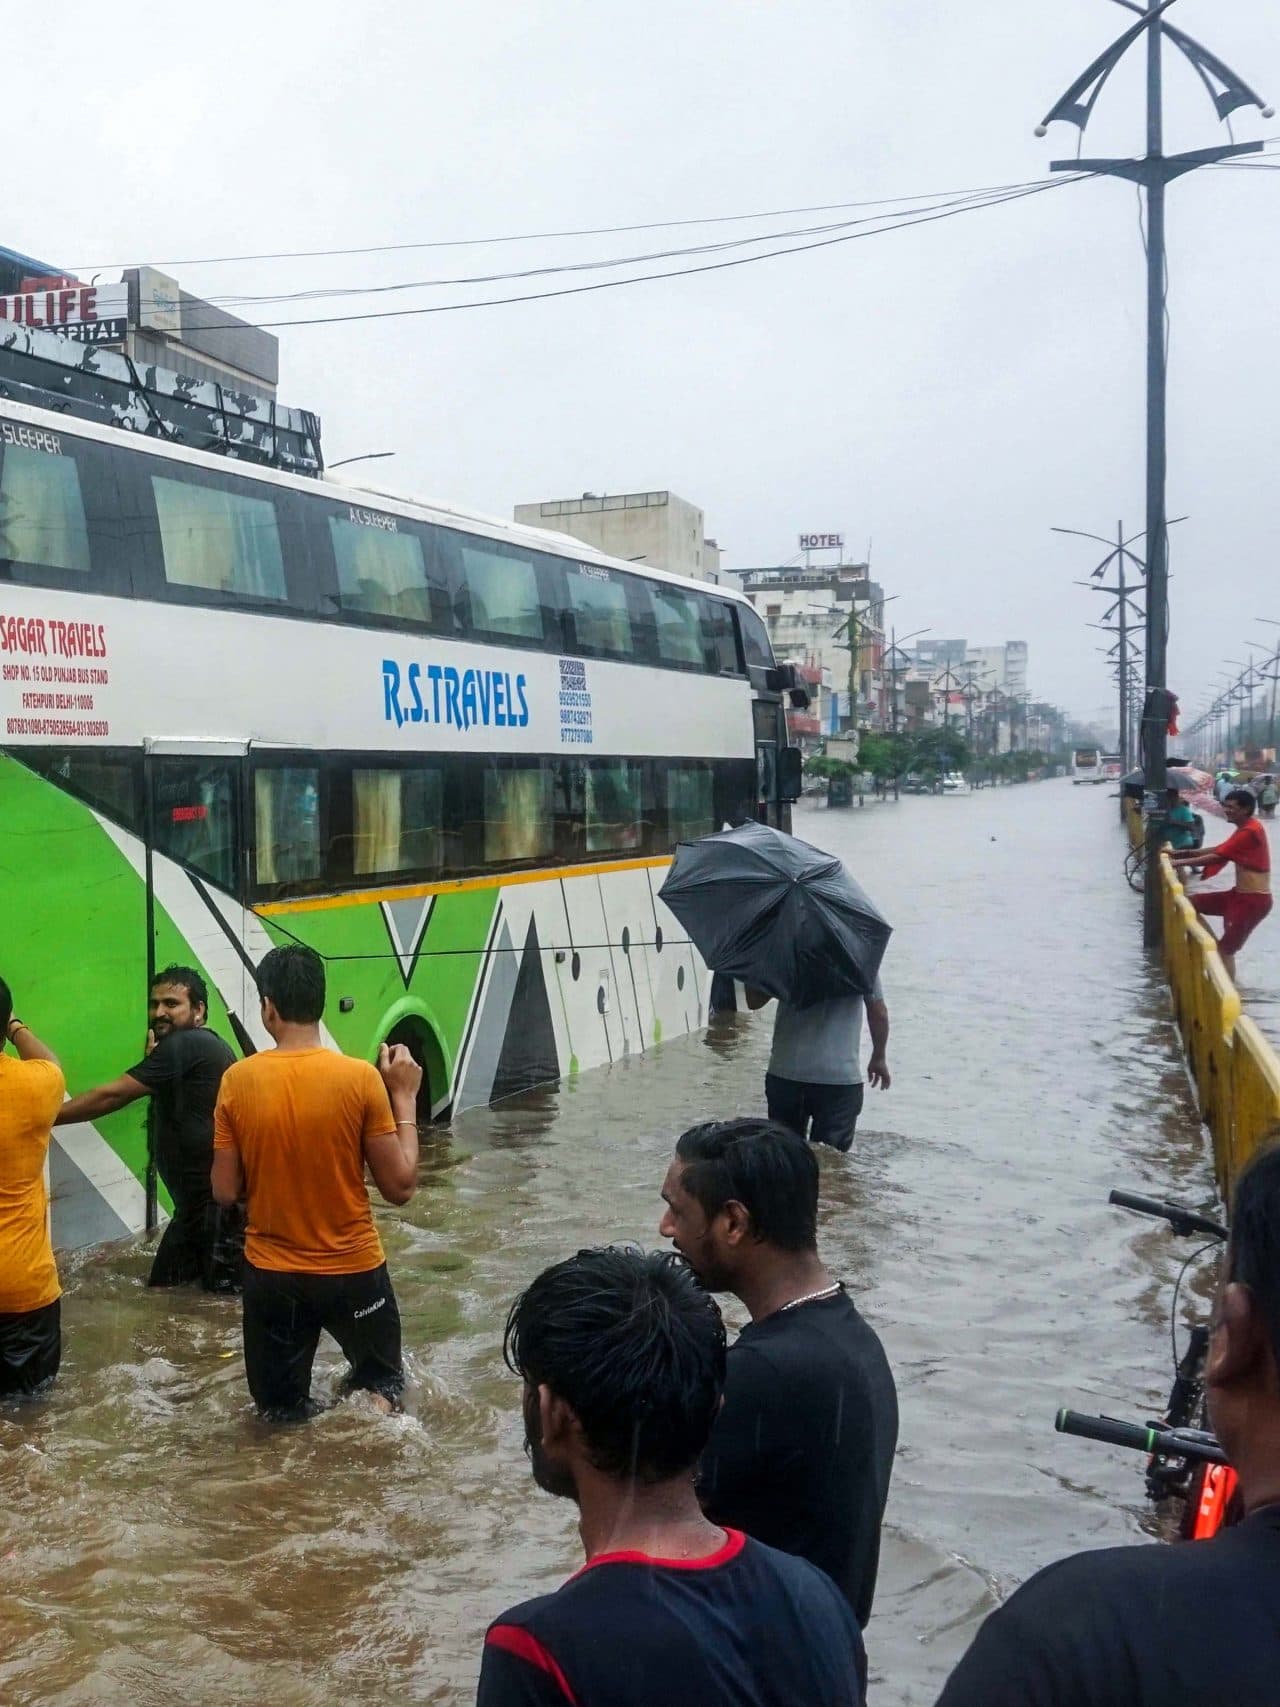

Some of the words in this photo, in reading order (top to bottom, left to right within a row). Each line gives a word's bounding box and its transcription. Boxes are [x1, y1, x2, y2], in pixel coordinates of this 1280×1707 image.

[2, 423, 62, 455] SLEEPER
[800, 534, 844, 546] HOTEL
[0, 615, 47, 657] SAGAR
[48, 620, 106, 659] TRAVELS
[3, 665, 19, 681] SHOP
[20, 665, 32, 681] NO.
[33, 666, 40, 681] 15
[41, 666, 53, 682] OLD
[54, 667, 77, 683] PUNJAB
[77, 668, 89, 684] BUS
[90, 669, 108, 685] STAND
[22, 693, 55, 709] FATEHPURI
[55, 694, 94, 710] DELHI-110006
[382, 659, 529, 732] R.S.TRAVELS
